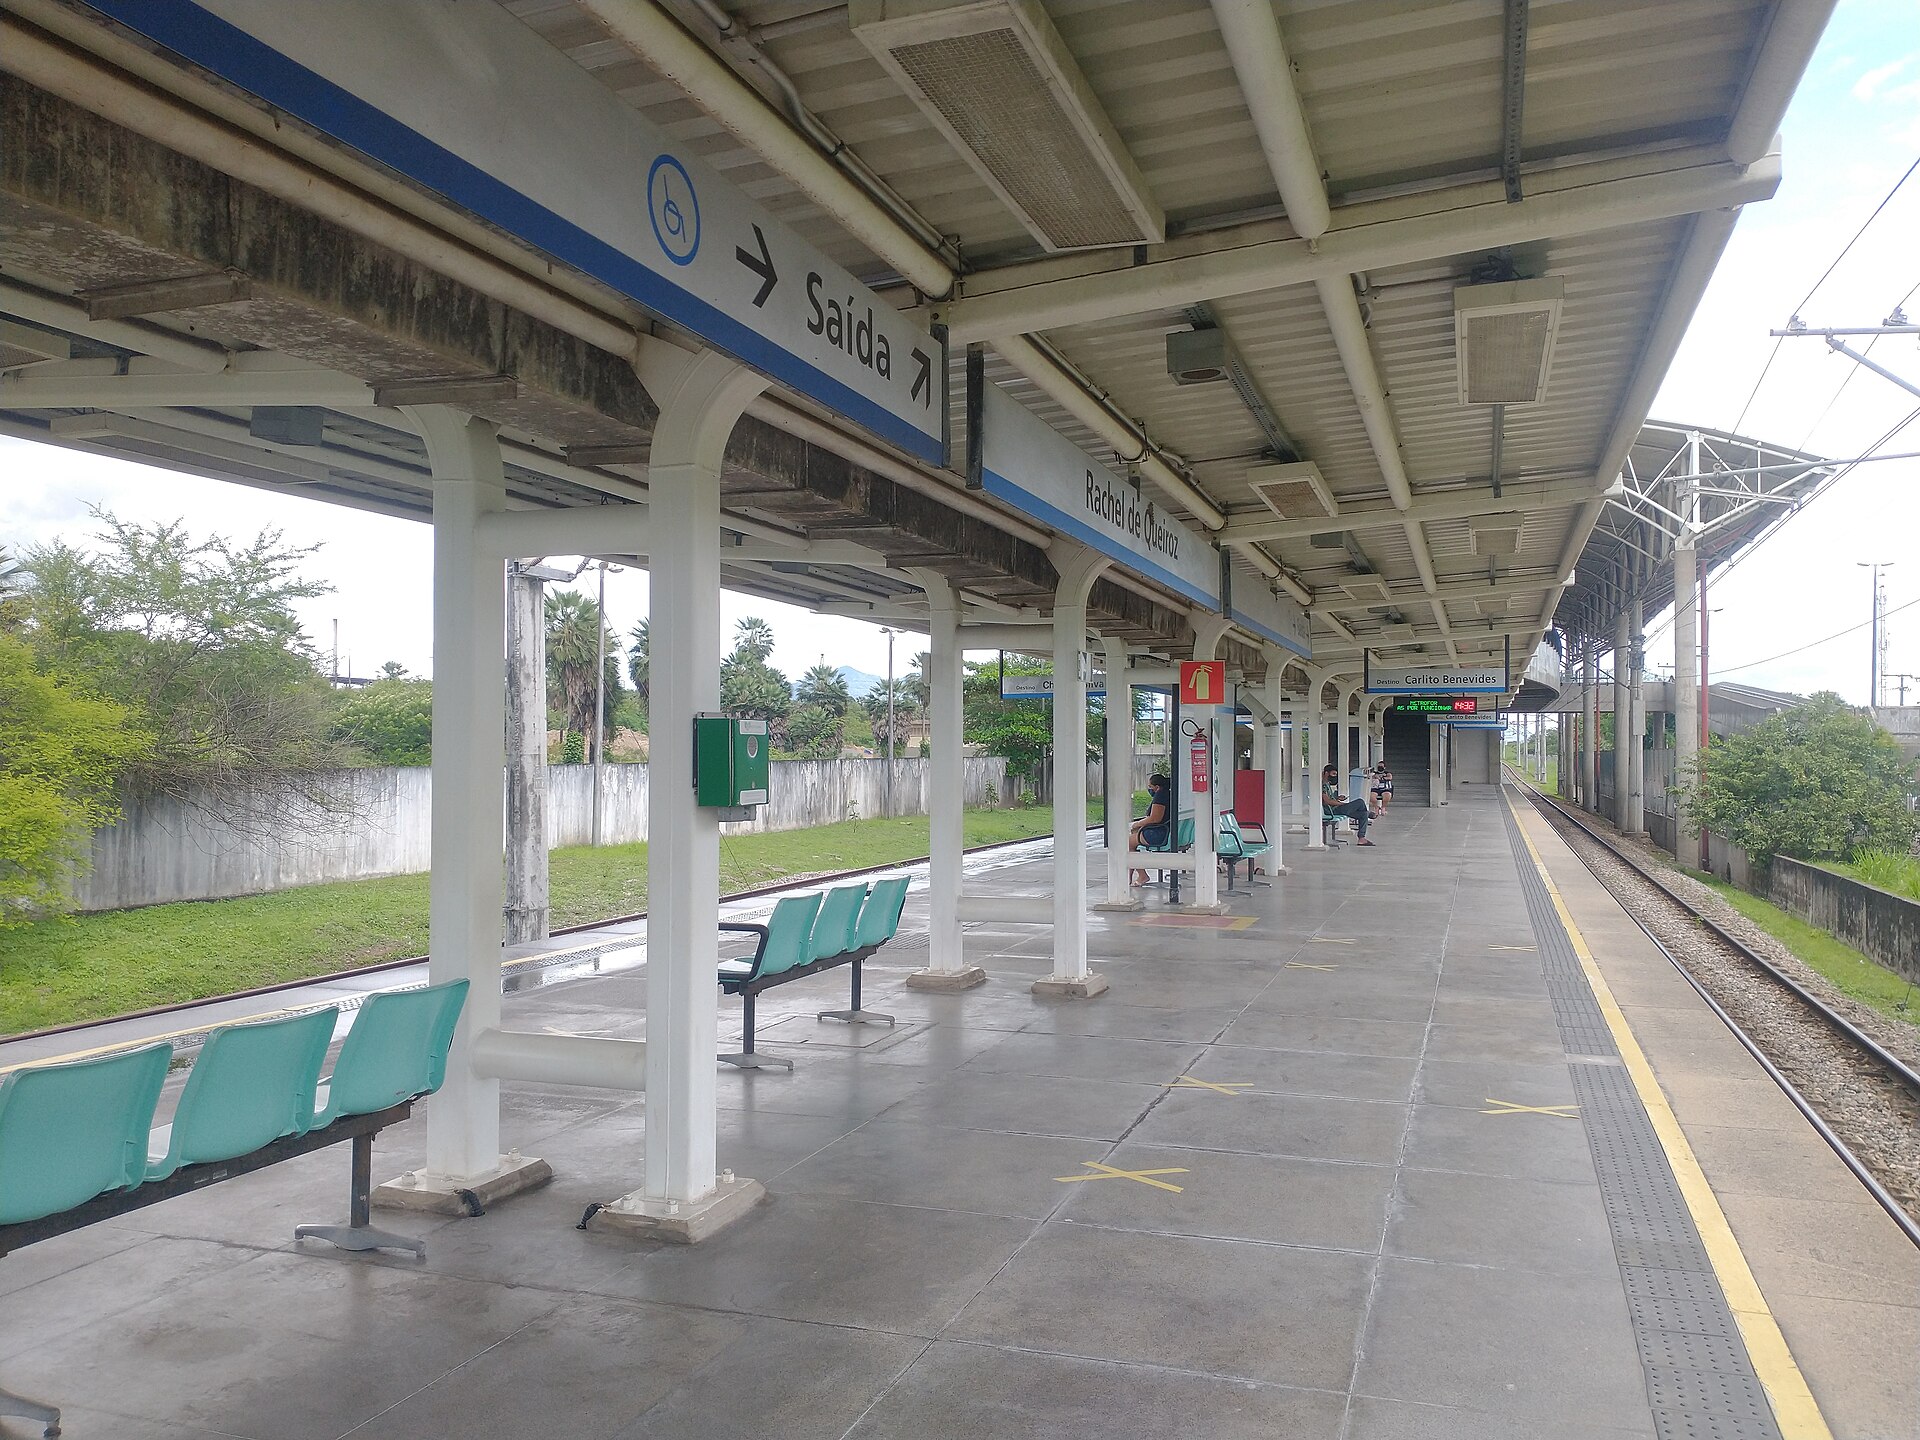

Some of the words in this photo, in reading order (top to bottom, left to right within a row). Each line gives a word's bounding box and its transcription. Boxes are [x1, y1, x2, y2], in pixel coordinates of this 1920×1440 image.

[806, 271, 891, 381] Saída
[1086, 468, 1125, 531] Rachel
[1128, 497, 1141, 538] de
[1144, 506, 1179, 561] Queiroz
[1405, 675, 1440, 685] Carlito
[1443, 674, 1497, 684] Benevides
[1454, 701, 1475, 710] 14:32
